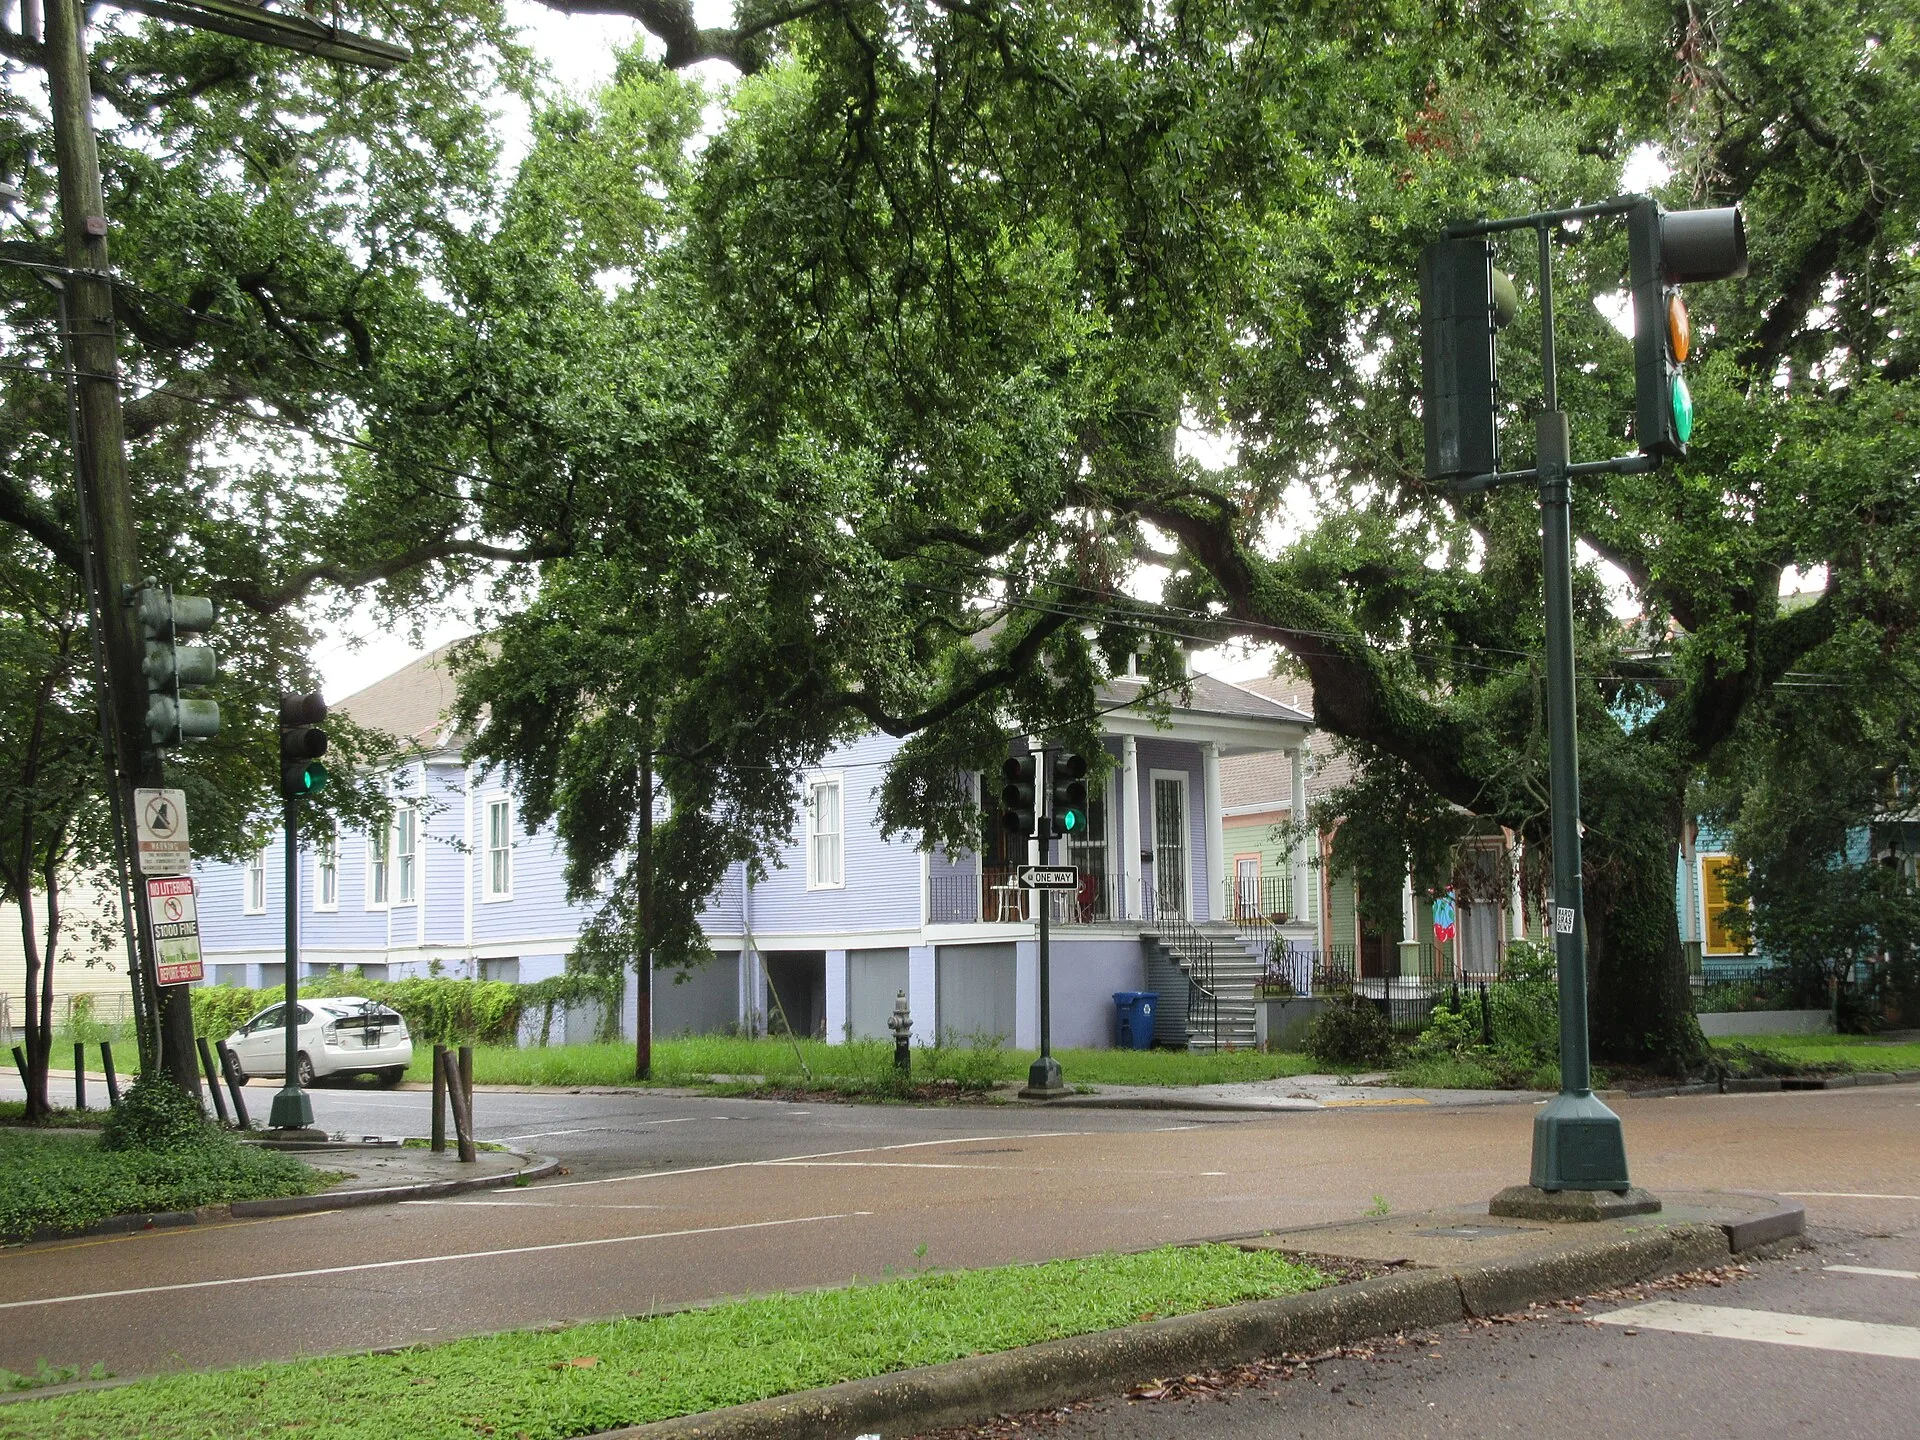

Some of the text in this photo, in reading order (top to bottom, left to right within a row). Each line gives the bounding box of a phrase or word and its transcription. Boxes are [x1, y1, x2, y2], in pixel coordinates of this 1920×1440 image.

[1036, 873, 1071, 882] ONE WAY
[150, 880, 192, 896] NO LITTERING
[155, 922, 197, 938] $1000 FINE
